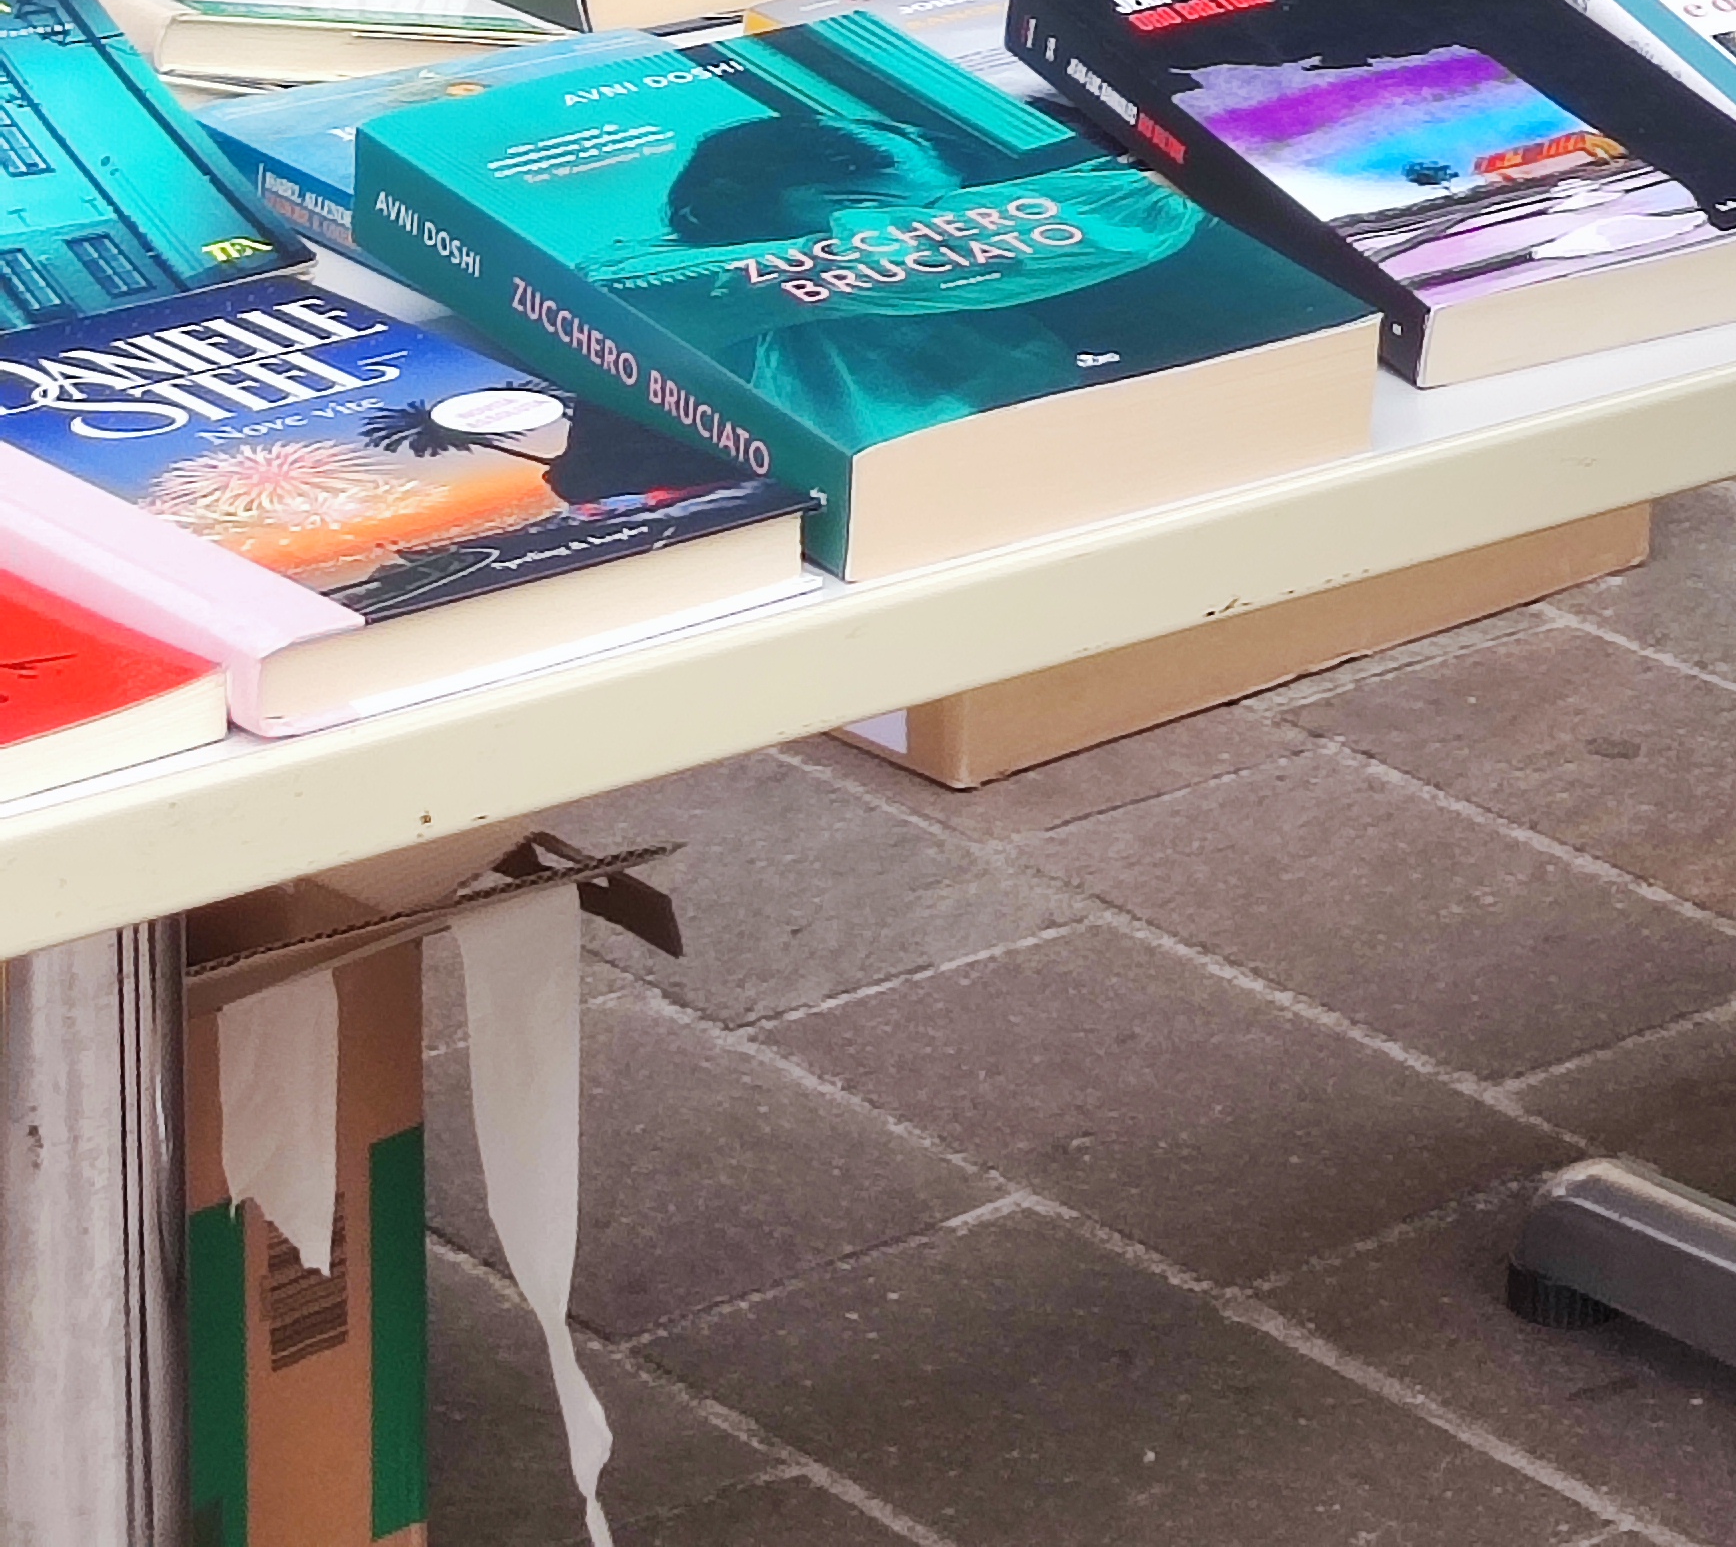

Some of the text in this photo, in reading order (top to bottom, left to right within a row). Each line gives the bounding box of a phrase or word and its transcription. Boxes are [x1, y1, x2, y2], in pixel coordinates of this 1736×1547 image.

[1683, 0, 1707, 19] e
[564, 59, 745, 107] AVNI DOSHI
[737, 197, 1061, 286] ZUCCHERO
[781, 223, 1084, 305] BRUCIATO
[375, 190, 419, 237] AVNI
[423, 220, 482, 279] DOSHI
[512, 276, 639, 386] ZUCCHERO
[648, 369, 771, 476] BRUCIATO
[70, 351, 409, 440] STEEL
[202, 393, 386, 449] Nove vite
